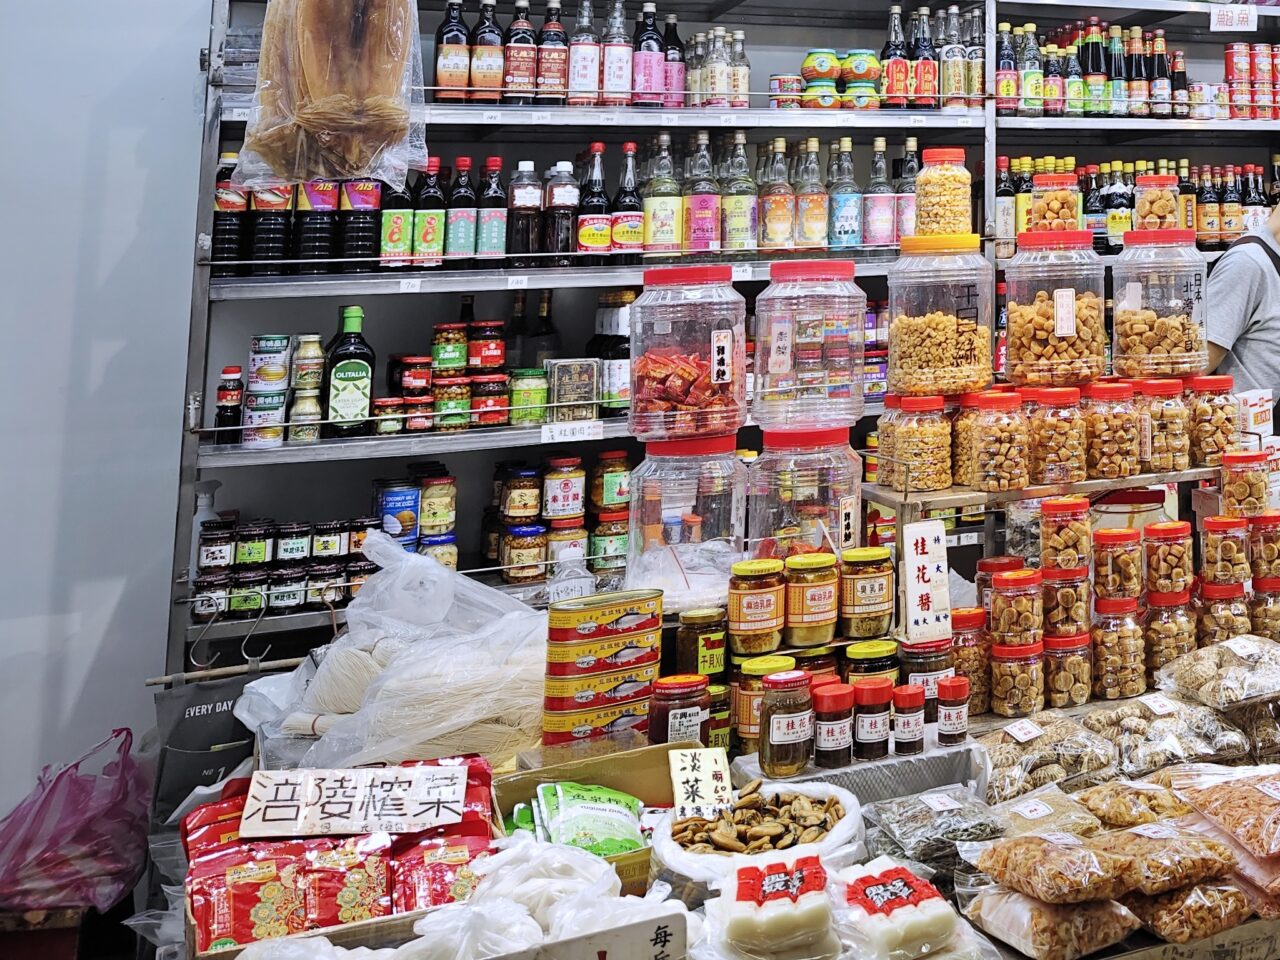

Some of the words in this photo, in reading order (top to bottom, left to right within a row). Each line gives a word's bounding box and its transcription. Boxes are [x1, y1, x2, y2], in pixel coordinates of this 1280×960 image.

[1215, 9, 1250, 27] 鮑魚
[336, 370, 367, 380] OLITALIA
[914, 537, 932, 612] 桂花醬
[185, 703, 212, 719] EVERY
[214, 699, 233, 712] DAY
[680, 751, 705, 804] 淡菜
